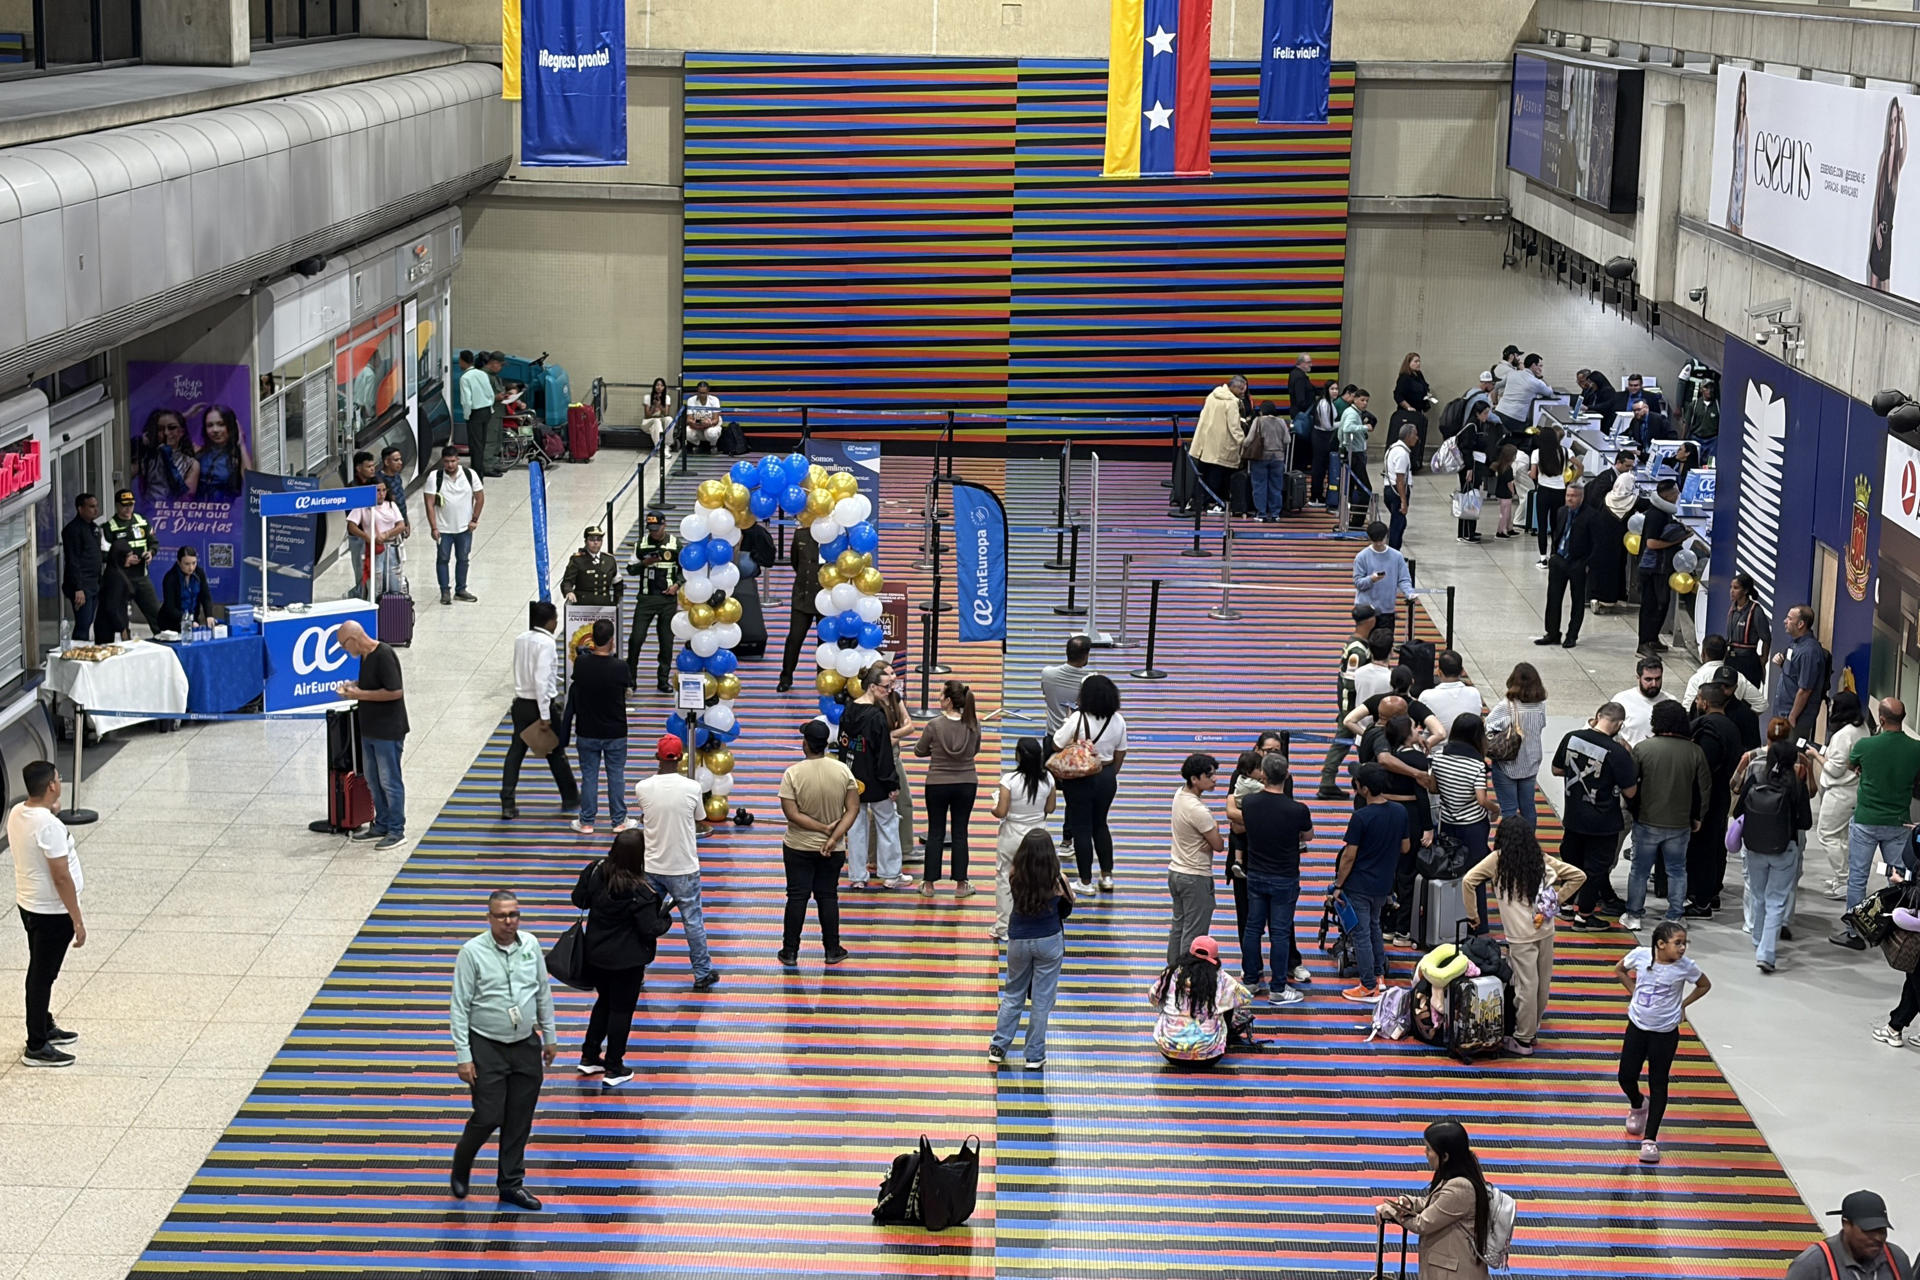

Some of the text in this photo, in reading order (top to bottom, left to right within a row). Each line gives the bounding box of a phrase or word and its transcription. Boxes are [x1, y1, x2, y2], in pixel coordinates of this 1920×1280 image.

[1296, 46, 1320, 59] viaje!
[539, 47, 610, 72] ¡Regresa pronto!
[811, 454, 834, 463] Somos
[825, 464, 854, 473] mliners.
[155, 501, 231, 511] EL SECRETO
[311, 496, 347, 507] AirEuropa
[187, 510, 202, 518] EN
[205, 511, 229, 519] QUE
[152, 516, 233, 534] Te Diviertas
[977, 529, 989, 597] AirEuropa
[294, 679, 350, 696] AirEurop
